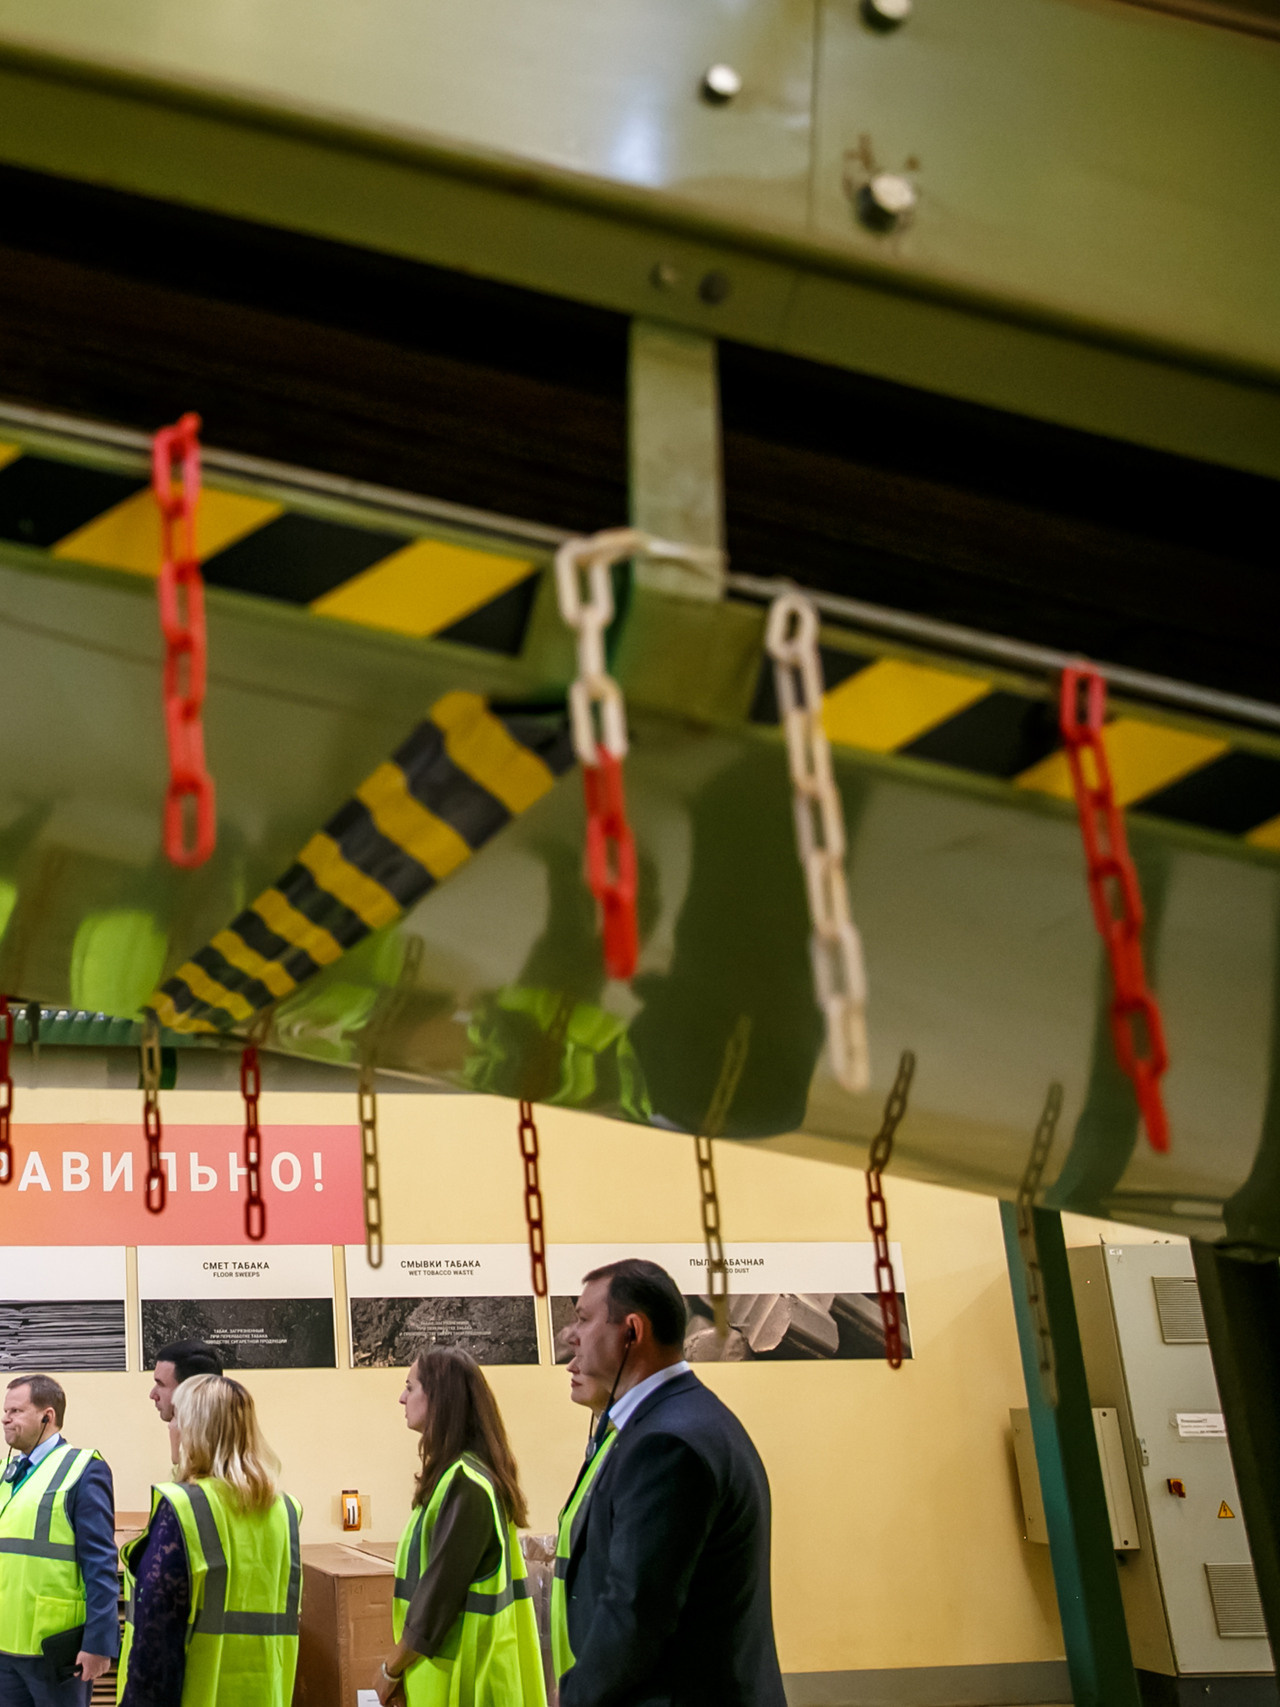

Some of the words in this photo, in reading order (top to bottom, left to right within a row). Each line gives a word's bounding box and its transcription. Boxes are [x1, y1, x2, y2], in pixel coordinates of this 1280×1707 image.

[202, 1261, 229, 1270] СМЕТ
[231, 1261, 270, 1270] ТАБАКА
[400, 1260, 442, 1269] СМЫВКИ
[444, 1259, 481, 1268] ТАБАКА
[722, 1258, 765, 1266] АБАЧНАЯ
